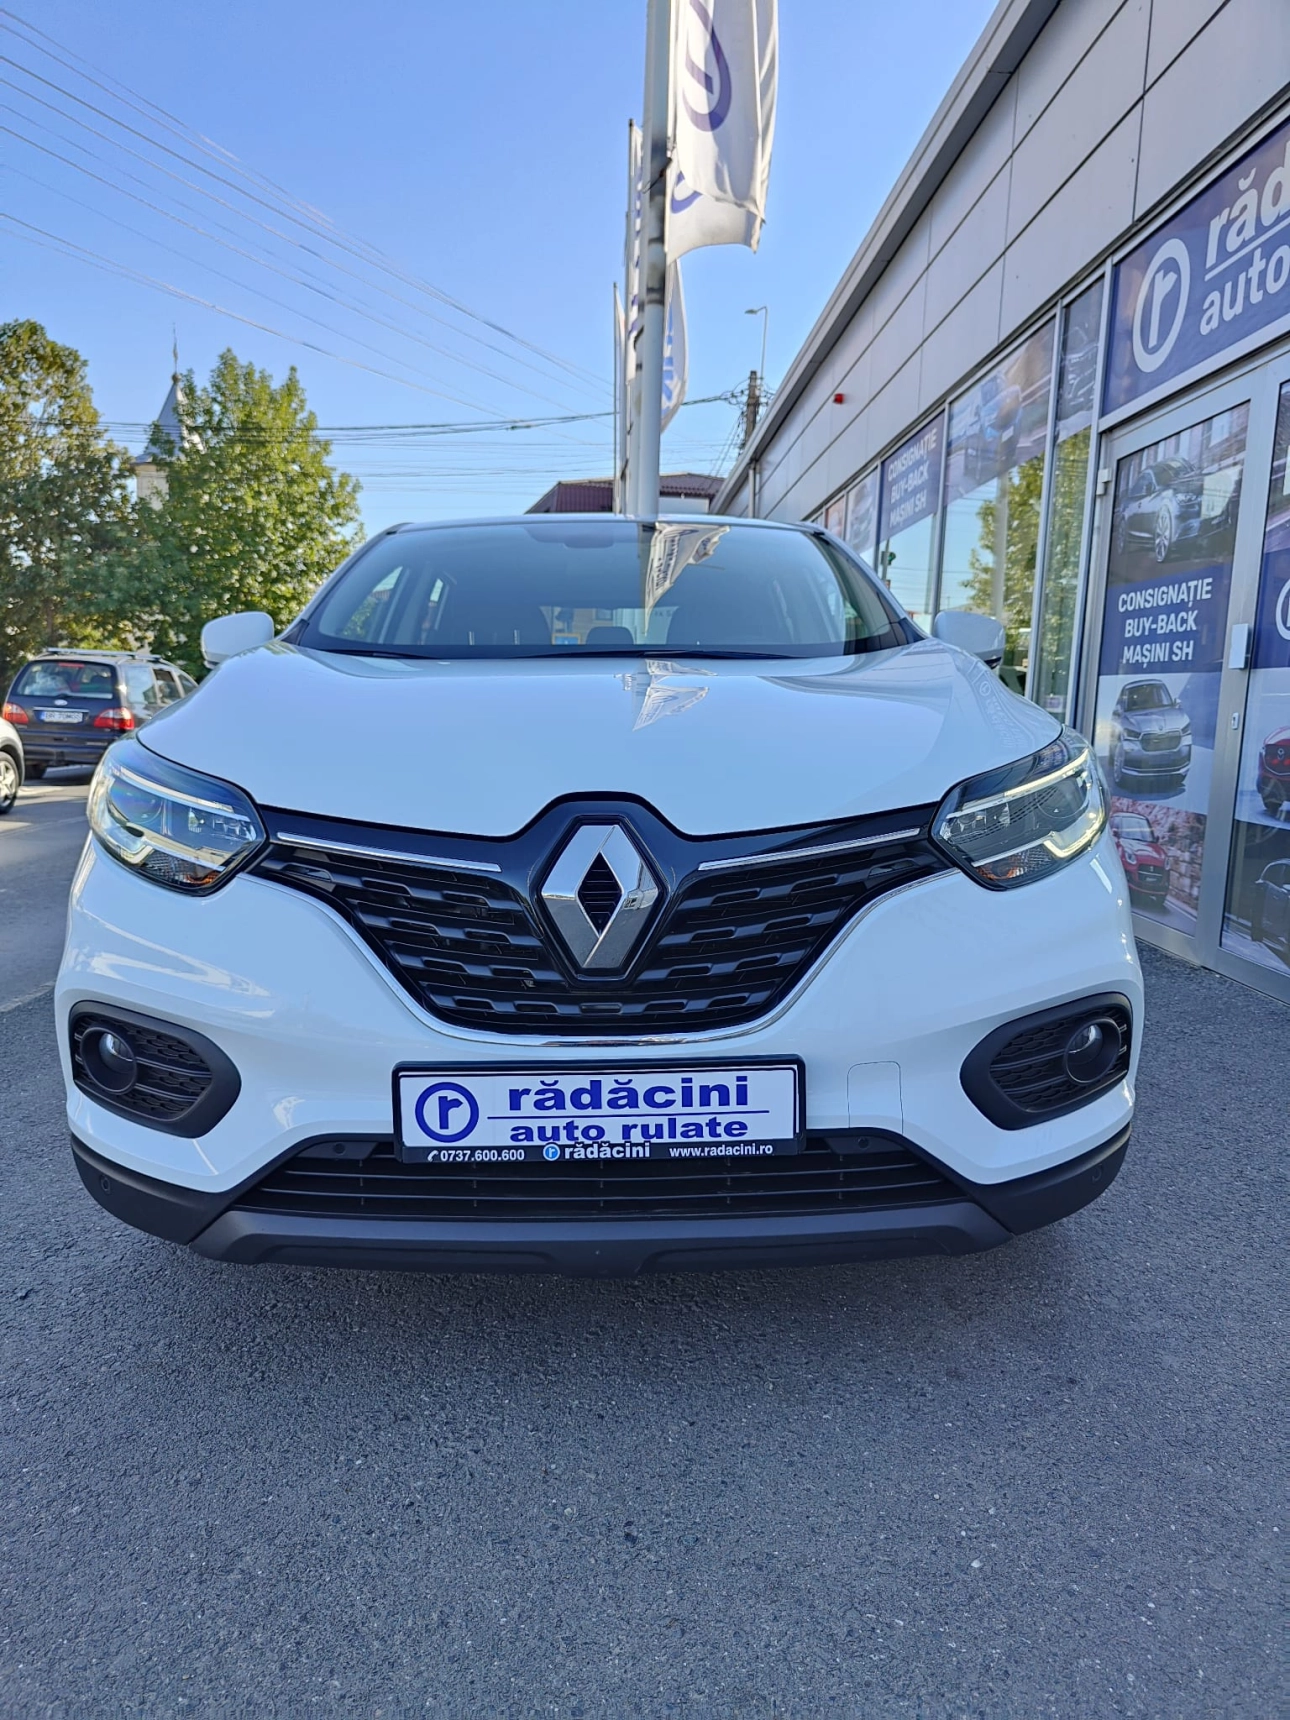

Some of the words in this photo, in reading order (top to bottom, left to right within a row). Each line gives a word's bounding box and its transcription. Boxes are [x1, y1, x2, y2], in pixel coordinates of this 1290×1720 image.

[1200, 247, 1290, 336] auto
[890, 460, 930, 504] BUY-BACK
[915, 490, 927, 513] SH
[1118, 577, 1213, 612] CONSIGNAȚIE
[1124, 610, 1198, 638] BUY-BACK
[1122, 641, 1170, 668] MAȘINI
[1171, 640, 1194, 661] SH
[508, 1075, 749, 1111] rădăcini
[510, 1117, 606, 1143] auto
[621, 1116, 749, 1141] rulate
[440, 1148, 525, 1162] 0737.600.600
[564, 1140, 651, 1159] rădăcini
[669, 1143, 773, 1157] www.radacini.ro
